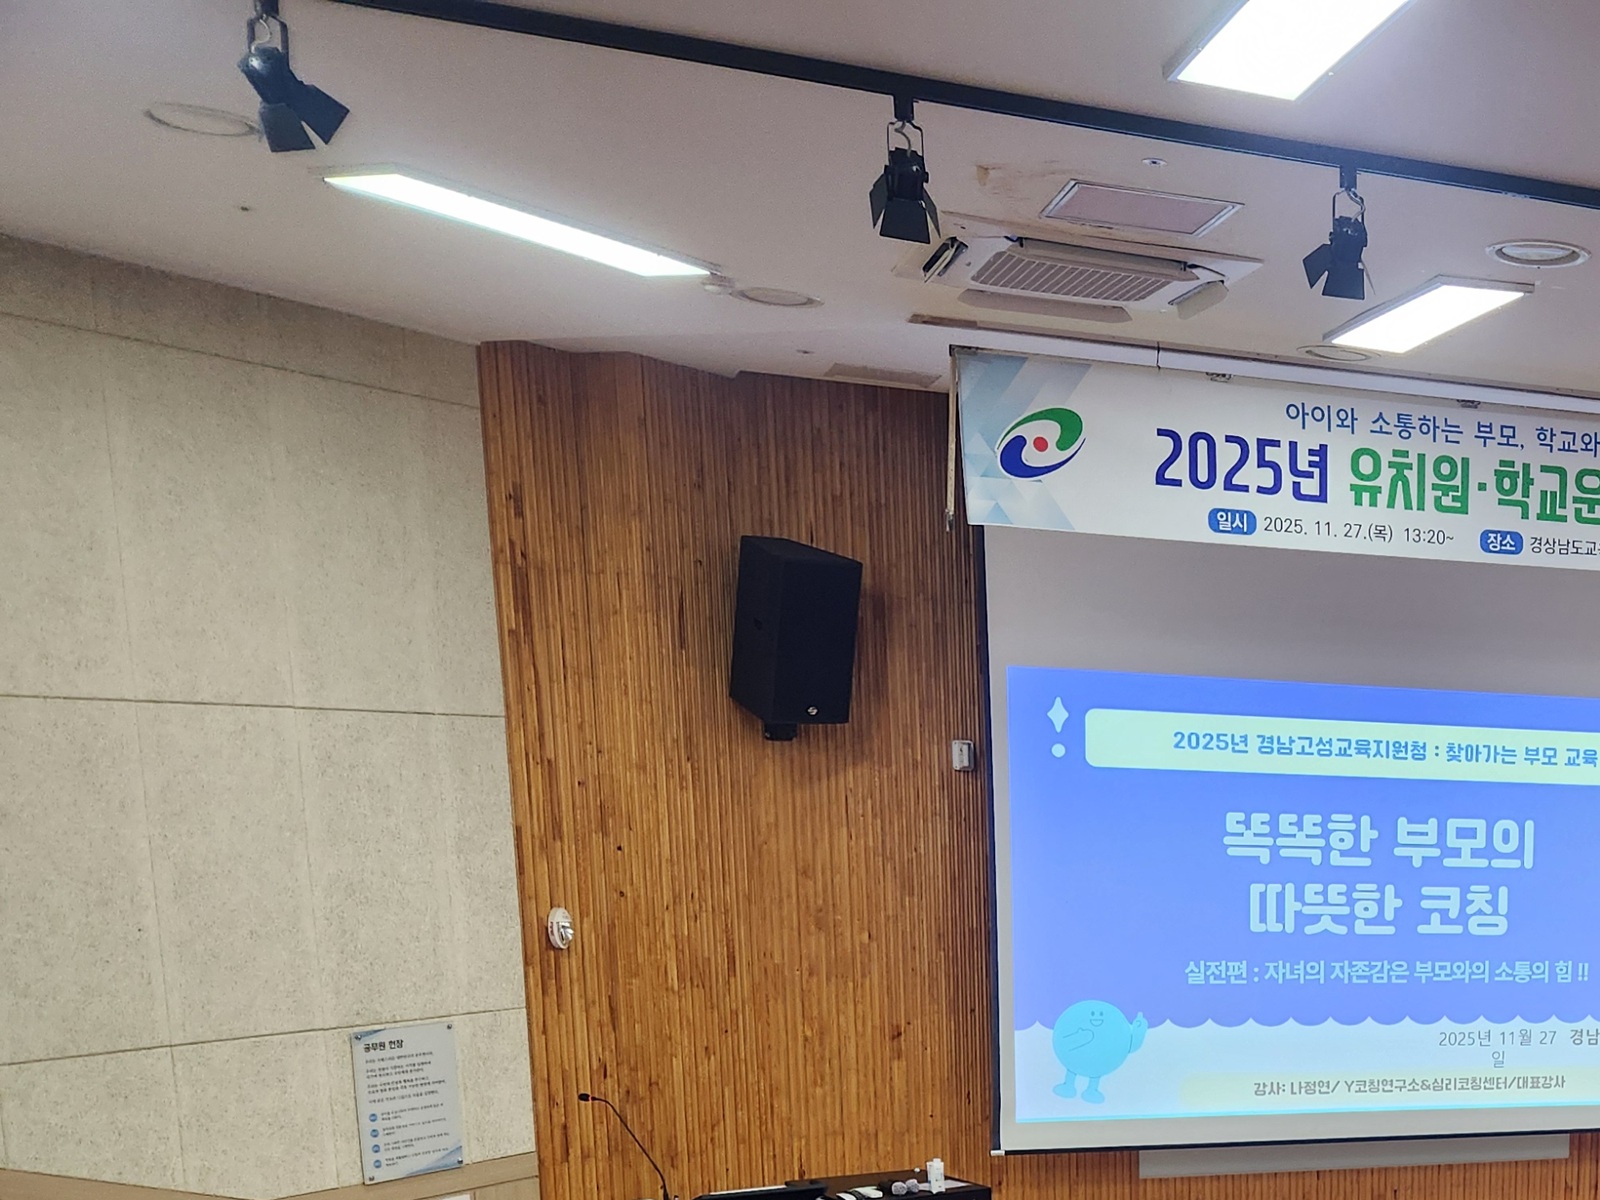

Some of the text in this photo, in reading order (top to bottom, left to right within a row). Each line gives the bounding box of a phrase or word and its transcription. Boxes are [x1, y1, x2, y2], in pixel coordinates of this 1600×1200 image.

[1286, 402, 1358, 434] 아이와
[1370, 411, 1464, 445] 소통하는
[1474, 420, 1525, 451] 부모,
[1535, 426, 1600, 458] 학교와
[1155, 427, 1328, 504] 2025년
[1216, 511, 1248, 533] 일시
[1263, 516, 1308, 536] 2025.
[1314, 521, 1338, 538] 11.
[1486, 532, 1516, 552] 장소
[1173, 731, 1249, 754] 2025년
[1256, 734, 1427, 762] 경남고성교육지원청
[1446, 742, 1518, 765] 찾아가는
[1524, 746, 1558, 766] 부모
[1564, 747, 1599, 768] 교육
[1223, 811, 1535, 869] 똑똑한 부모의
[1249, 882, 1509, 936] 따뜻한 코칭
[1184, 959, 1248, 985] 실전편
[1264, 960, 1325, 984] 자녀의
[1330, 959, 1410, 984] 자존감은
[1413, 960, 1490, 983] 부모와의
[1494, 960, 1549, 983] 소통의
[1554, 960, 1573, 983] 힘
[1438, 1028, 1557, 1047] 2025년 11월 27
[1491, 1050, 1506, 1069] 일
[1253, 1081, 1286, 1097] 강사:
